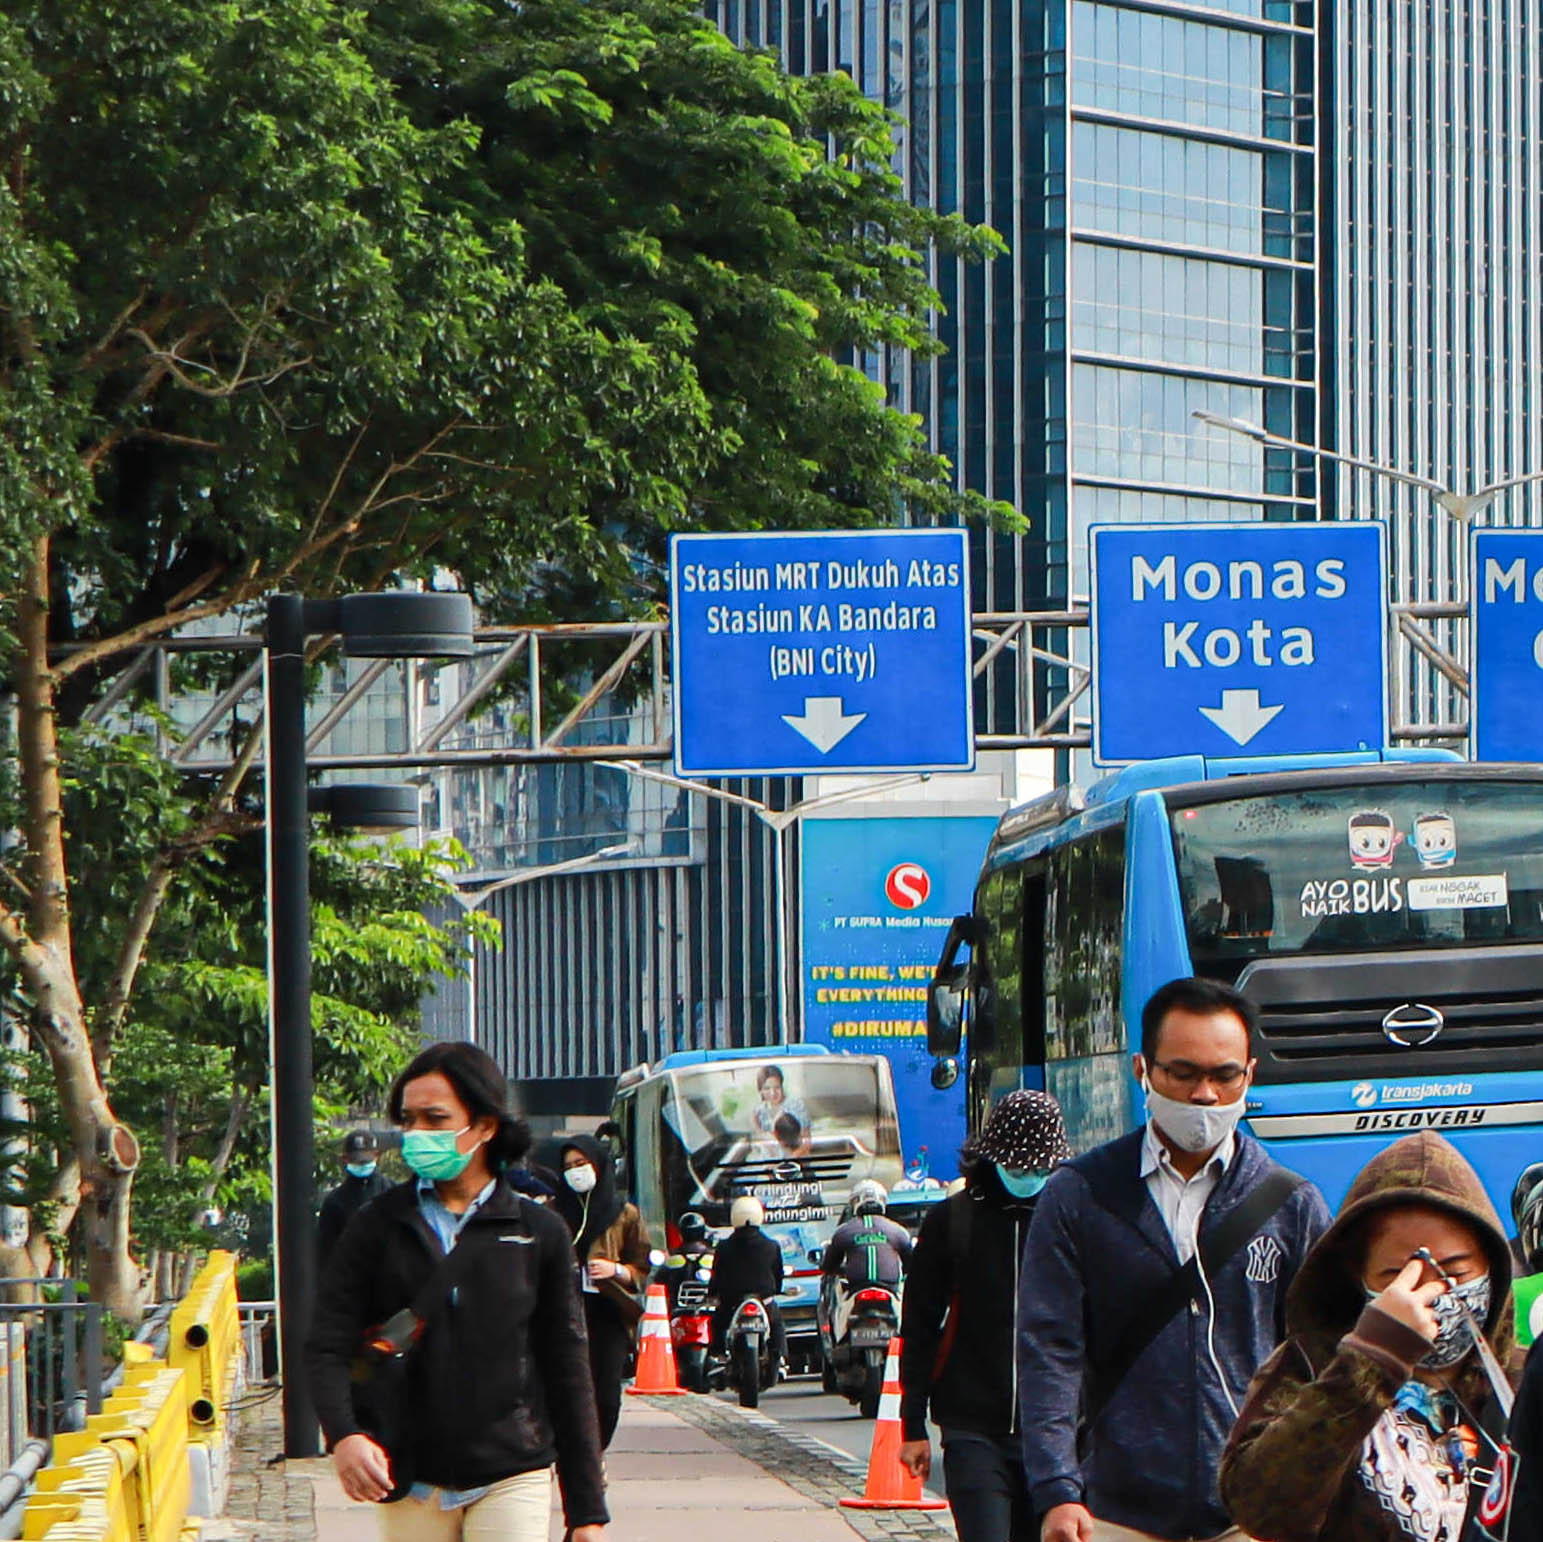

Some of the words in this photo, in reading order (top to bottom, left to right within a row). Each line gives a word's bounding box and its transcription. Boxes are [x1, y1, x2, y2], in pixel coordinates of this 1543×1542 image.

[684, 561, 769, 592] Stasiun
[776, 562, 820, 590] MRT
[828, 559, 899, 590] Dukuh
[906, 559, 960, 588] Atas
[1132, 555, 1347, 602] Monas
[707, 602, 793, 634] Stasiun
[799, 604, 831, 632] KA
[839, 602, 937, 631] Bandara
[1163, 619, 1315, 668] Kota
[769, 646, 814, 680] (BNI
[821, 643, 876, 682] City)
[1300, 879, 1350, 901] AYO
[1352, 877, 1402, 914] BUS
[1456, 891, 1498, 905] MACET
[1301, 900, 1351, 917] NAIK
[812, 966, 845, 980] IT'S
[849, 966, 895, 982] FINE,
[816, 987, 928, 1003] EVERYTHING
[1381, 1081, 1473, 1103] transjakarta
[1355, 1108, 1486, 1131] DISCOVERY
[745, 1181, 823, 1197] Terlindungi
